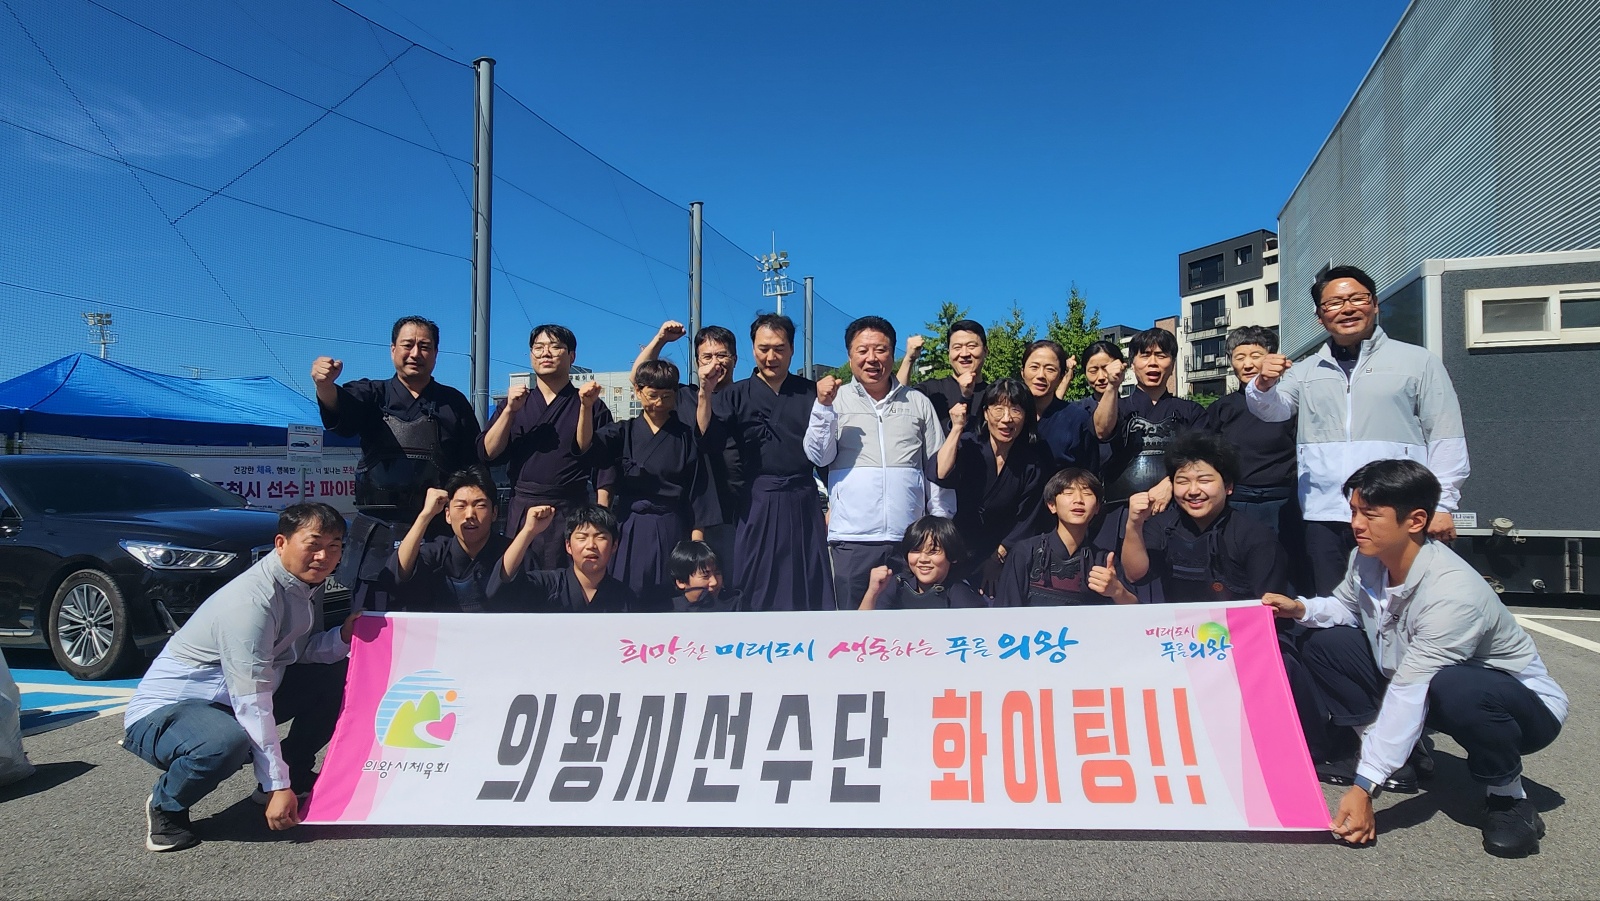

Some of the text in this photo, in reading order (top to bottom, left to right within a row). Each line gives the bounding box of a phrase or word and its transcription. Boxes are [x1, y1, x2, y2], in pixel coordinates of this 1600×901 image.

[233, 465, 254, 474] 건강한
[256, 465, 274, 474] 체육,
[276, 466, 296, 474] 행복한
[323, 466, 341, 474] 빛나는
[267, 480, 315, 498] 선수단
[1145, 624, 1195, 641] 미래도시
[619, 626, 1080, 664] 희망찬 미래도시 생동하는 푸른 의왕
[476, 688, 1206, 805] 의왕시선수단 화이팅!!
[363, 760, 450, 779] 의왕시체육회
